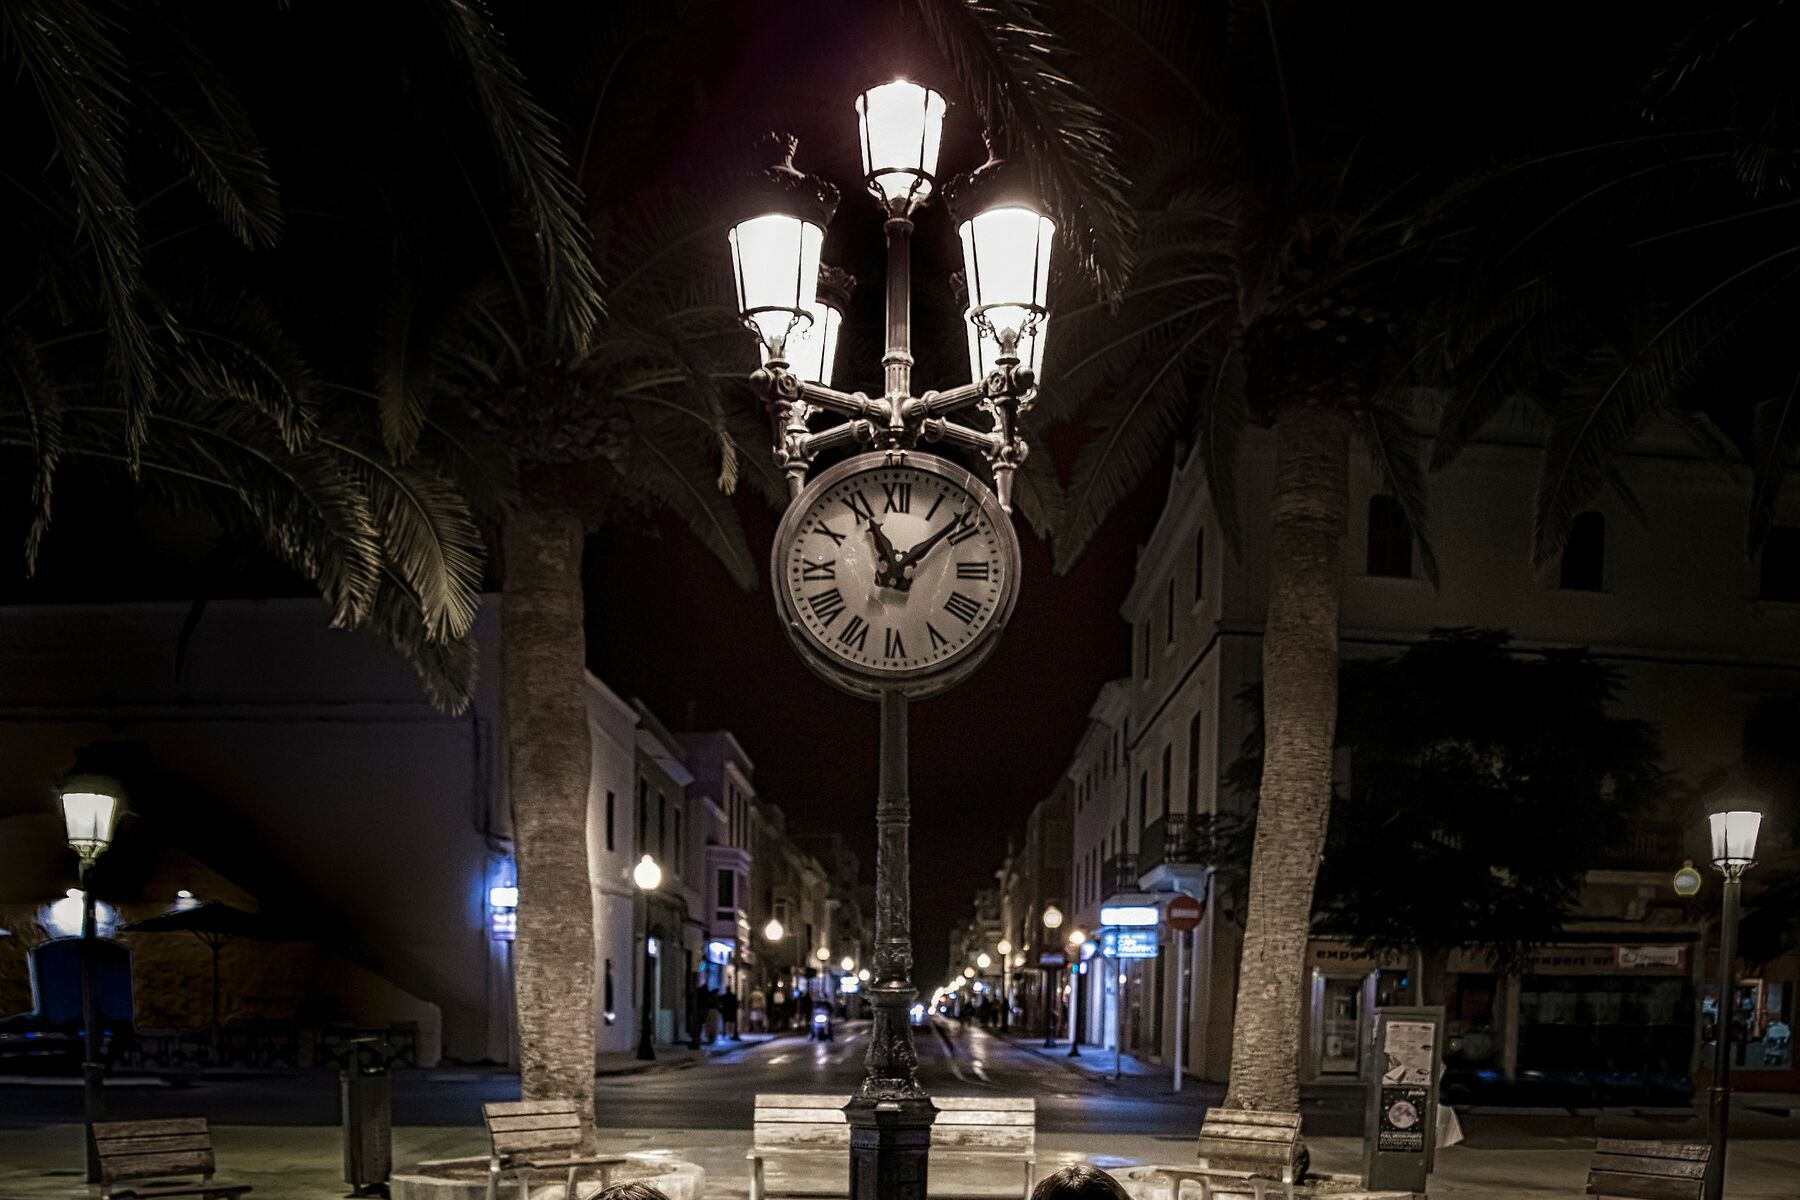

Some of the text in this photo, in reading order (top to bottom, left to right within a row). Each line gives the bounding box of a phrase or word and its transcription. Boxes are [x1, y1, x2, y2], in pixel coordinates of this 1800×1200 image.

[841, 490, 875, 526] XI
[881, 483, 912, 514] XII
[925, 494, 945, 522] I
[813, 520, 847, 547] X
[802, 558, 836, 582] IX
[956, 561, 989, 581] III
[808, 588, 846, 629] VIII
[943, 592, 982, 625] IIII
[838, 615, 869, 651] VII
[882, 627, 907, 659] VI
[926, 621, 949, 651] V
